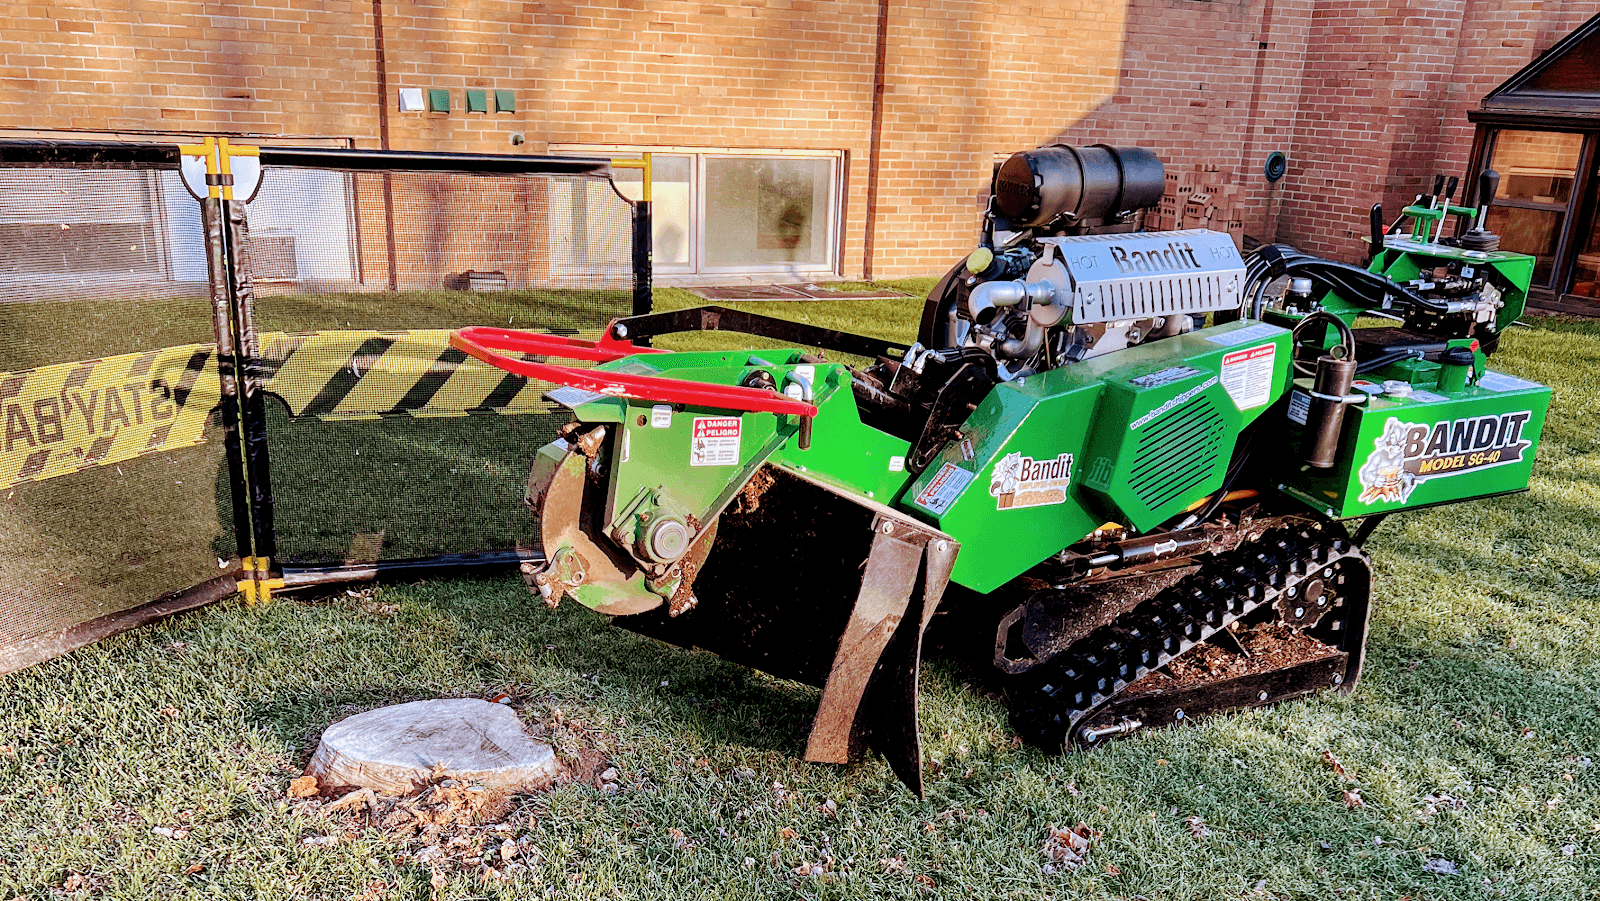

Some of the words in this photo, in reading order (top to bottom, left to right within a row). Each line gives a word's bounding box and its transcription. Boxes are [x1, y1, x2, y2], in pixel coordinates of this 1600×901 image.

[1069, 255, 1099, 270] HOT
[1109, 242, 1202, 274] Bandit
[1210, 246, 1237, 259] HOT
[706, 429, 738, 437] PELIGRO
[707, 420, 738, 428] DANGER
[1404, 413, 1530, 459] BANDIT
[1021, 455, 1072, 481] Bandit
[1418, 455, 1466, 474] MODEL
[1467, 450, 1502, 467] SG-40
